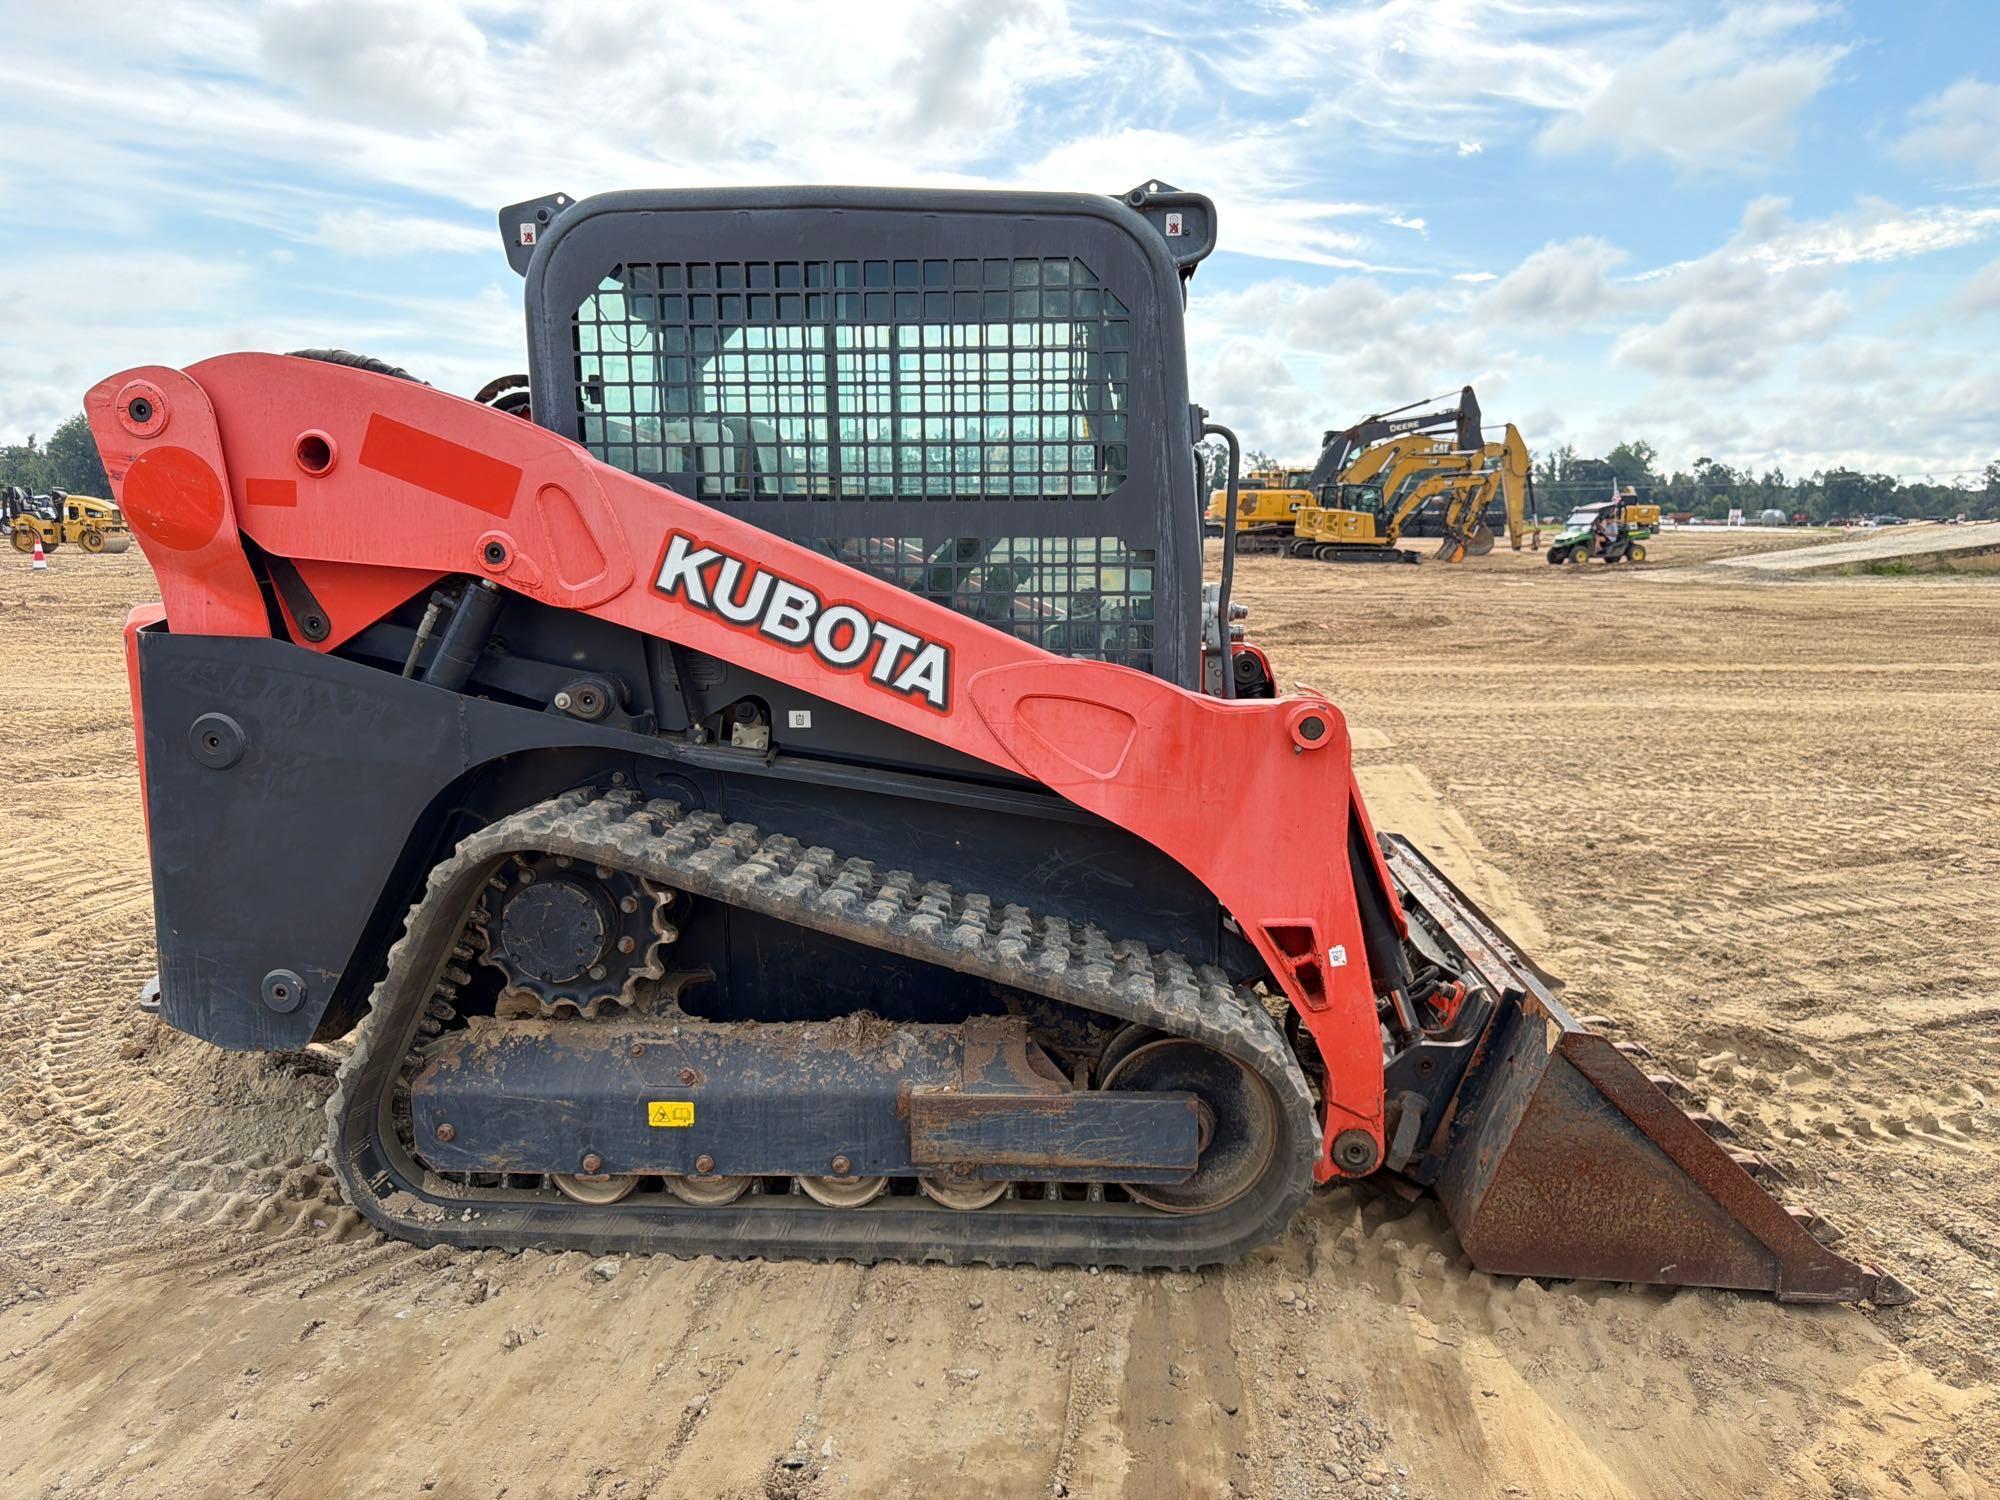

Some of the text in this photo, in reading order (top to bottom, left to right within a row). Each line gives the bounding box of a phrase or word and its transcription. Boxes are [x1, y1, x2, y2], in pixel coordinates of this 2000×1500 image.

[1389, 421, 1419, 432] DEERE
[1433, 443, 1449, 453] CAT
[656, 535, 946, 705] KUBOTA
